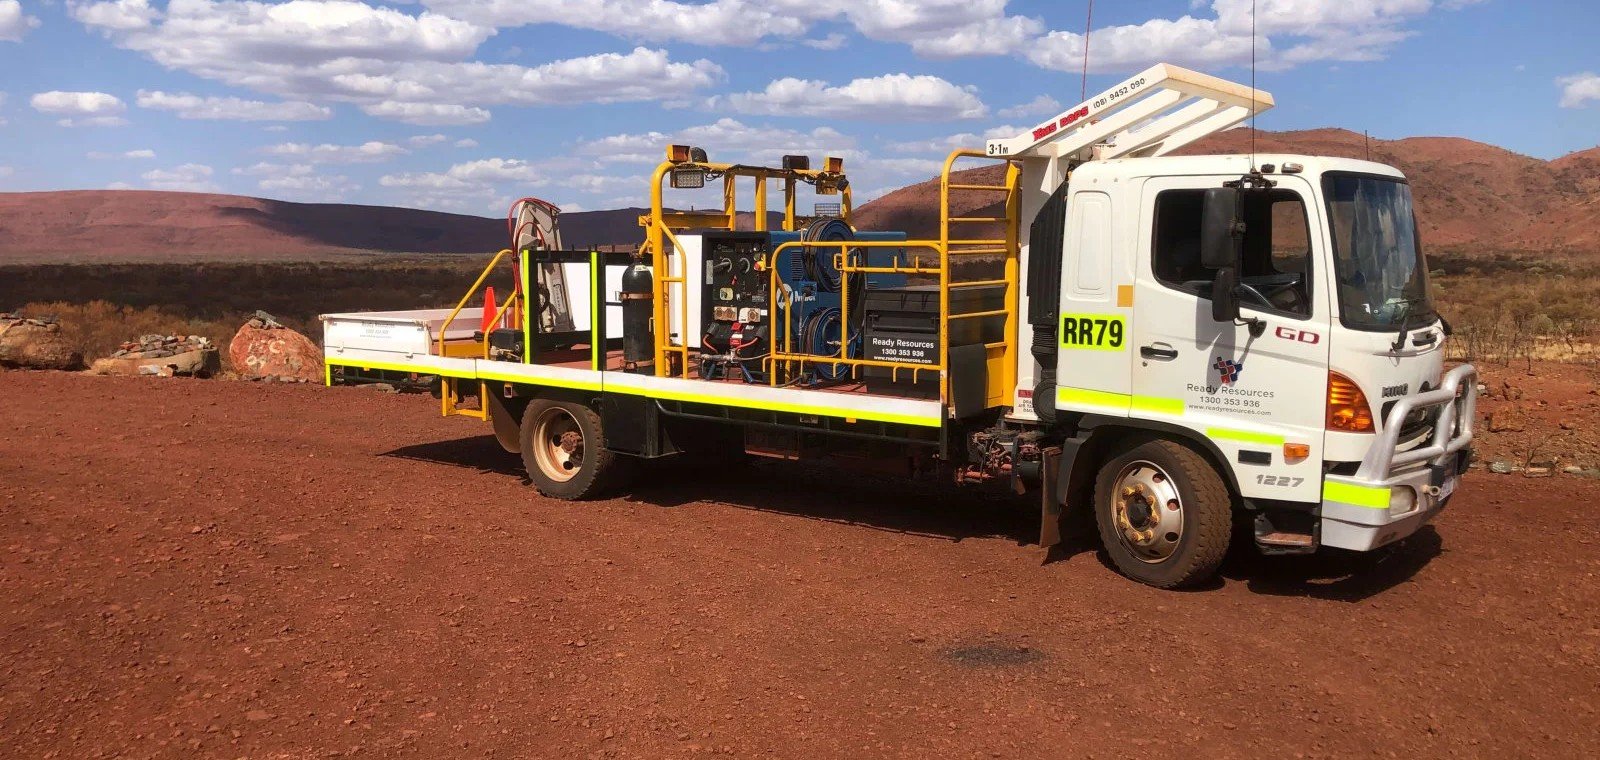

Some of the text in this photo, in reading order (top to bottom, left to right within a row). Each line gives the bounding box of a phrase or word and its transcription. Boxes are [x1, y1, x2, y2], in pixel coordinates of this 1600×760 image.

[1059, 105, 1089, 128] ROPS
[1093, 98, 1107, 109] (08)
[1109, 87, 1129, 101] 9452
[1063, 317, 1123, 348] RR79
[1275, 326, 1320, 345] GD
[872, 337, 934, 349] Ready Resources
[1186, 383, 1275, 398] Ready Resources
[1199, 396, 1260, 408] 1300 353 936
[1188, 404, 1272, 416] www.readyresources.com
[1256, 474, 1305, 487] 1227
